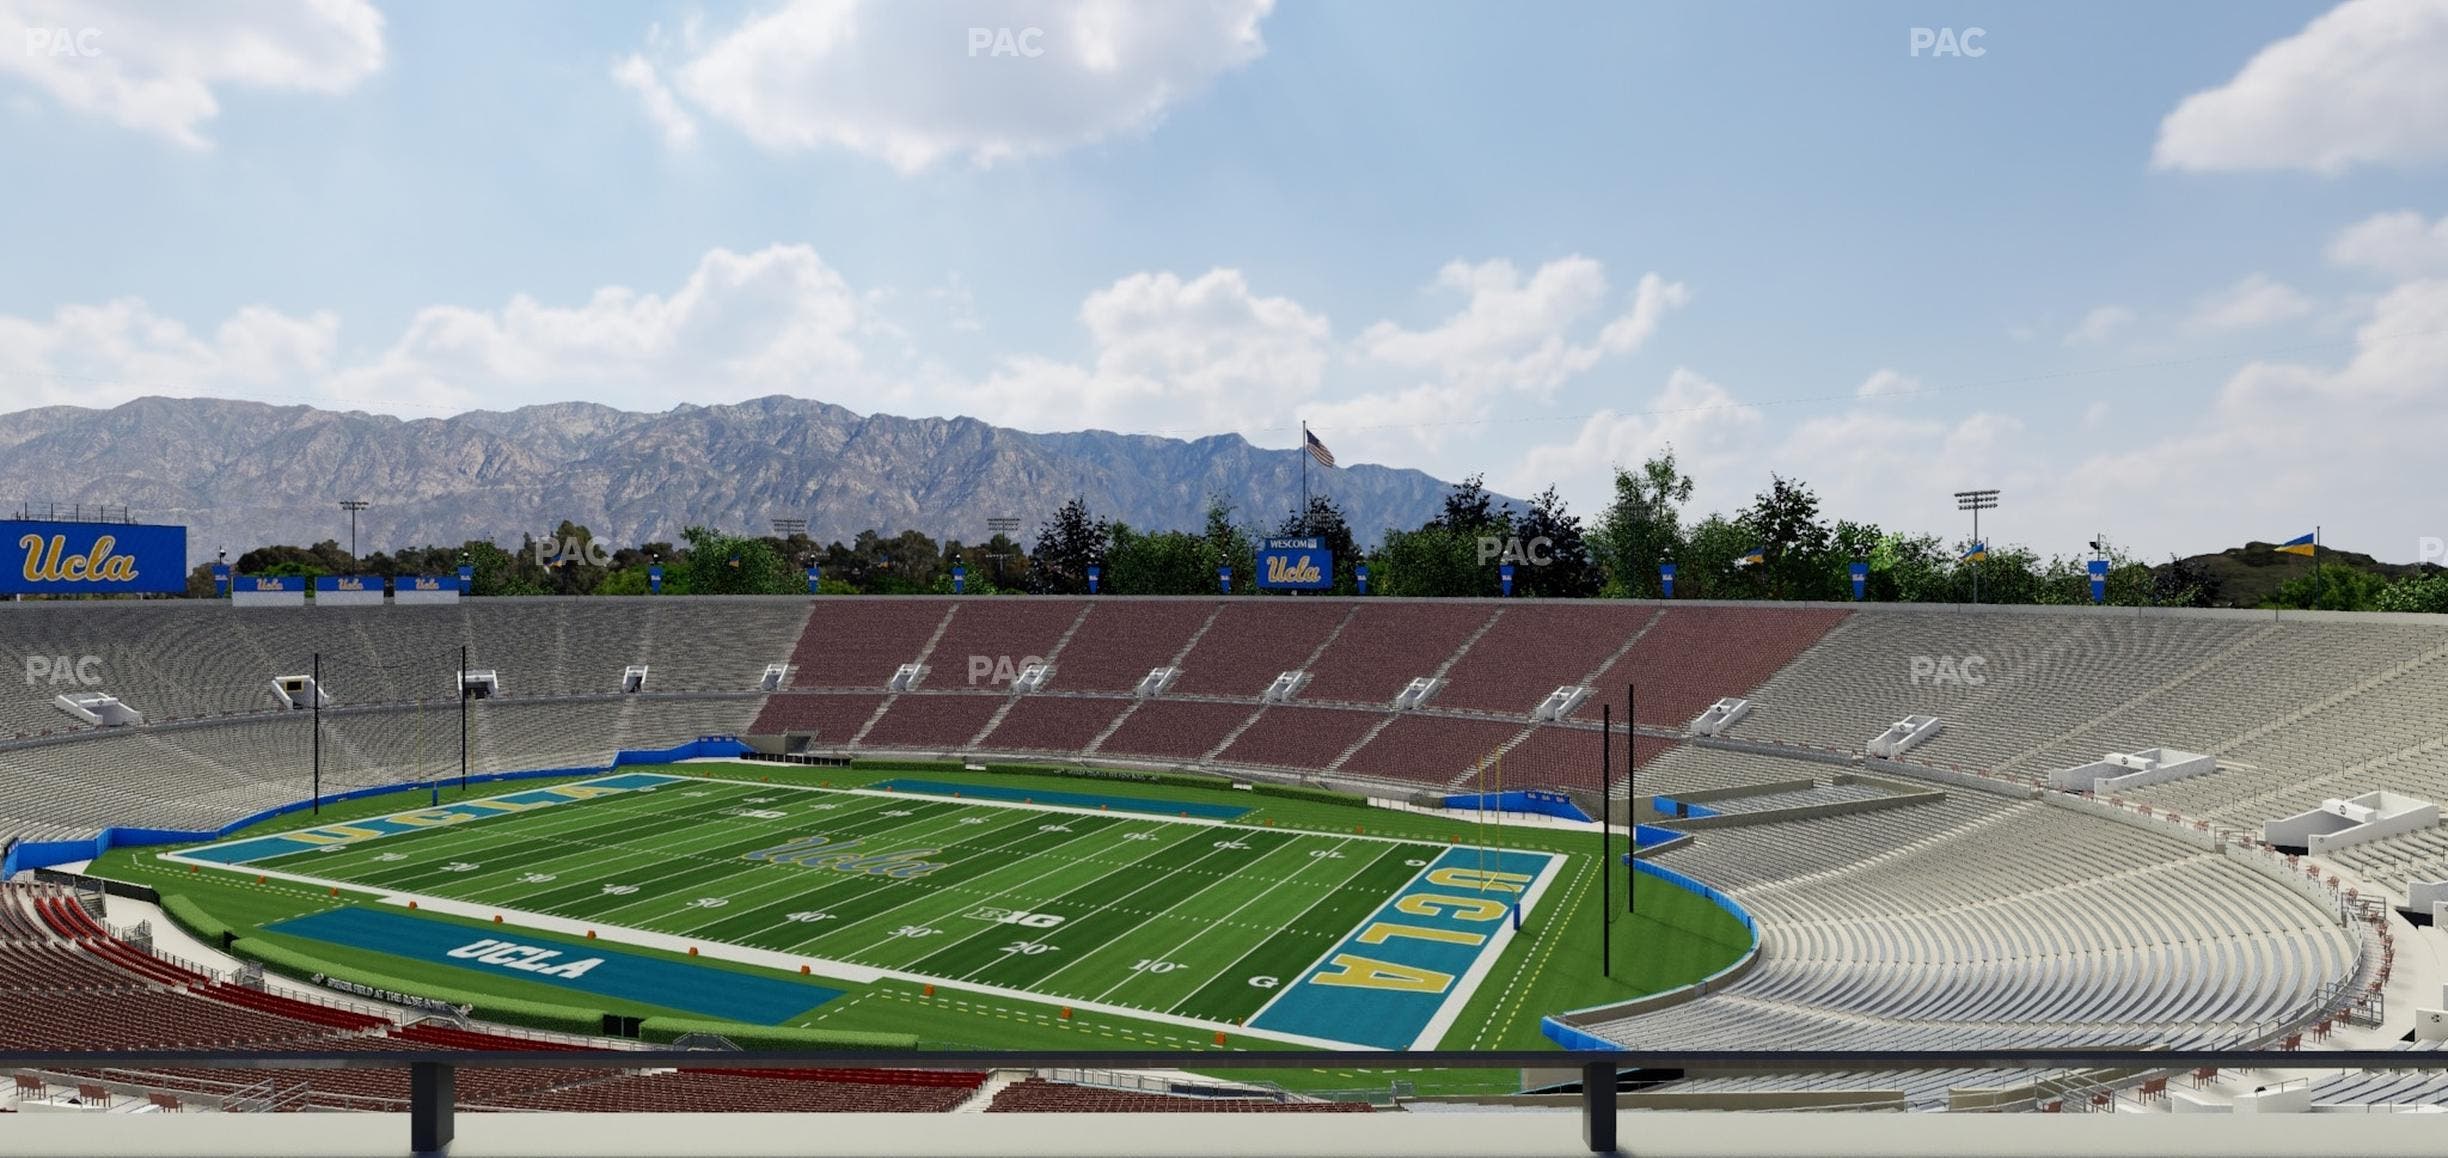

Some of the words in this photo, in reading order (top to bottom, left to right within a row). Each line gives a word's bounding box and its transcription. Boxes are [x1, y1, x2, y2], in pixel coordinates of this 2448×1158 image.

[1270, 539, 1308, 549] WESCOM
[19, 533, 140, 582] Ucla
[1266, 555, 1322, 583] Ucla
[278, 785, 628, 845] UCLA
[887, 925, 933, 939] 30
[1308, 867, 1533, 993] UCLA
[998, 941, 1049, 955] 20
[446, 938, 606, 980] UCLA
[1128, 959, 1176, 974] 10
[1248, 975, 1280, 989] G
[386, 990, 402, 1003] THE
